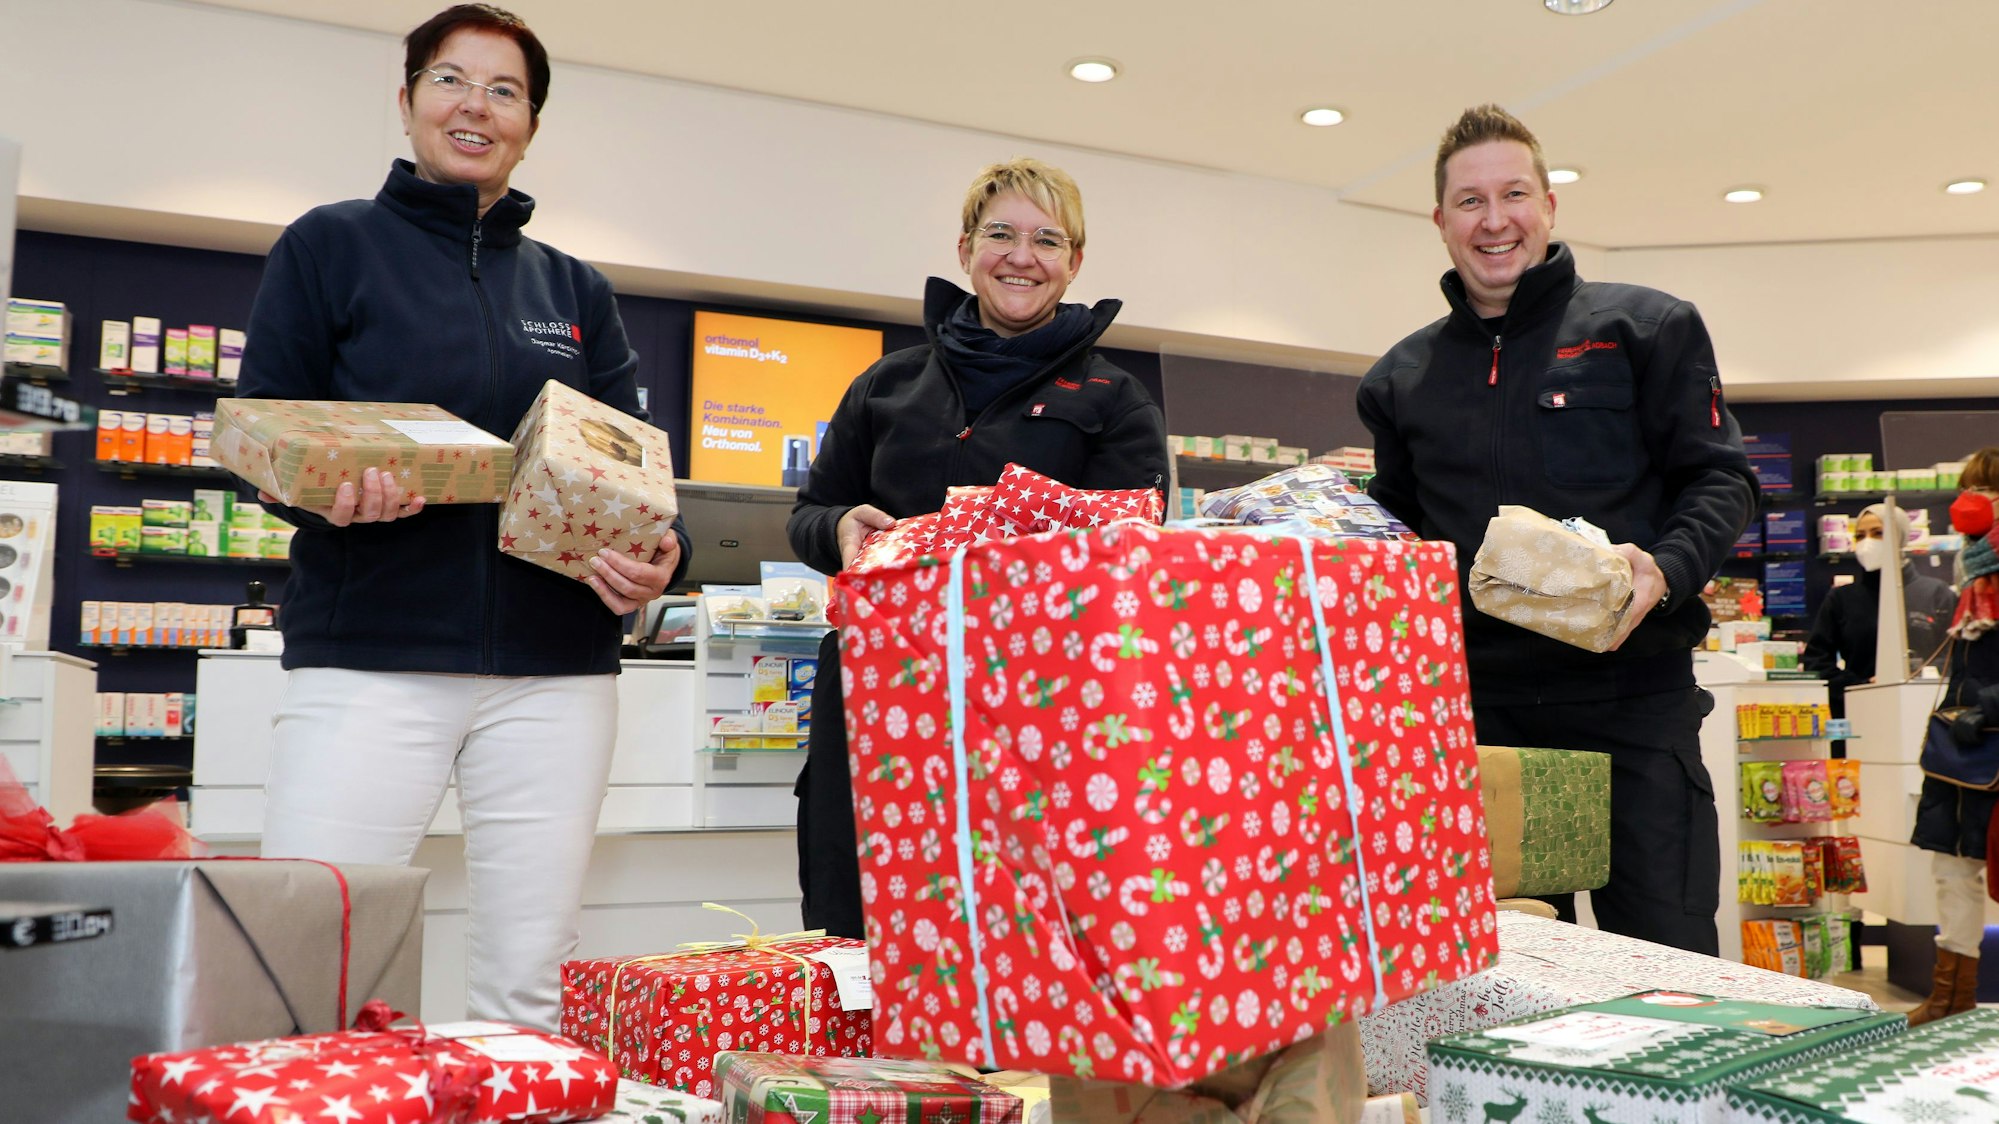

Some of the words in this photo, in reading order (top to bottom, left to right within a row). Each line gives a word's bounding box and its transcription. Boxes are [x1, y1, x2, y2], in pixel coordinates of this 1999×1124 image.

[521, 319, 571, 330] SCHLOSS
[523, 325, 572, 338] APOTHEKE
[705, 334, 760, 348] orthomol
[705, 344, 748, 358] vitamin
[703, 400, 723, 411] Die
[727, 402, 765, 415] starke
[703, 413, 783, 429] Kombination.
[702, 425, 728, 438] Neu
[730, 427, 753, 439] von
[702, 437, 762, 452] Orthomol.
